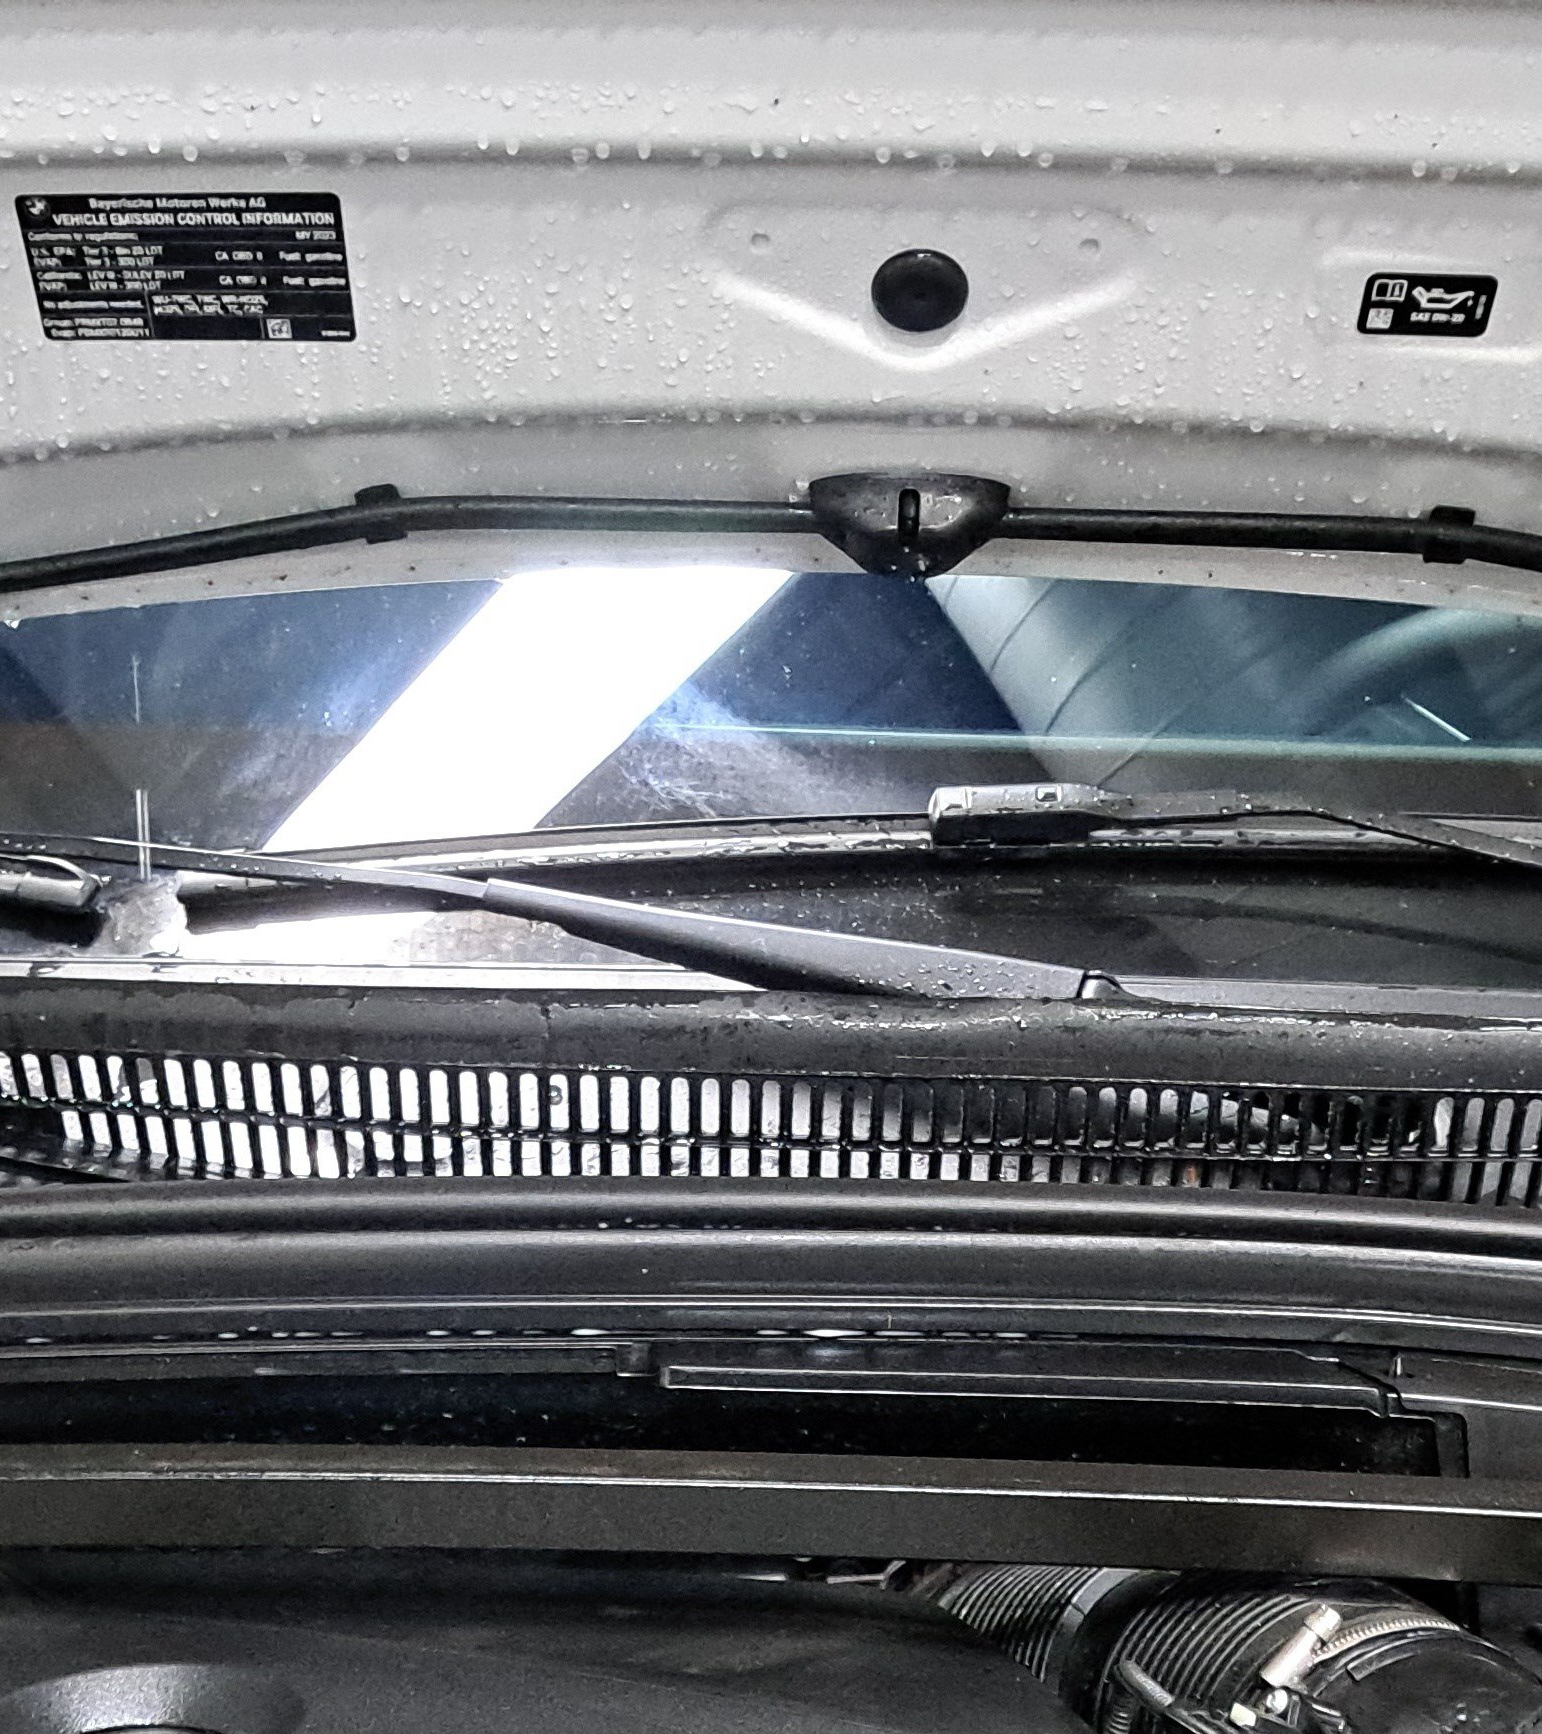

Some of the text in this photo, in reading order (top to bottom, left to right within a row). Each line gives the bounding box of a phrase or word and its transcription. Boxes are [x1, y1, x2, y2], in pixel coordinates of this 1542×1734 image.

[249, 197, 266, 208] AG
[52, 212, 335, 226] VEHICLE EMISSION CONTROL INFORMATION
